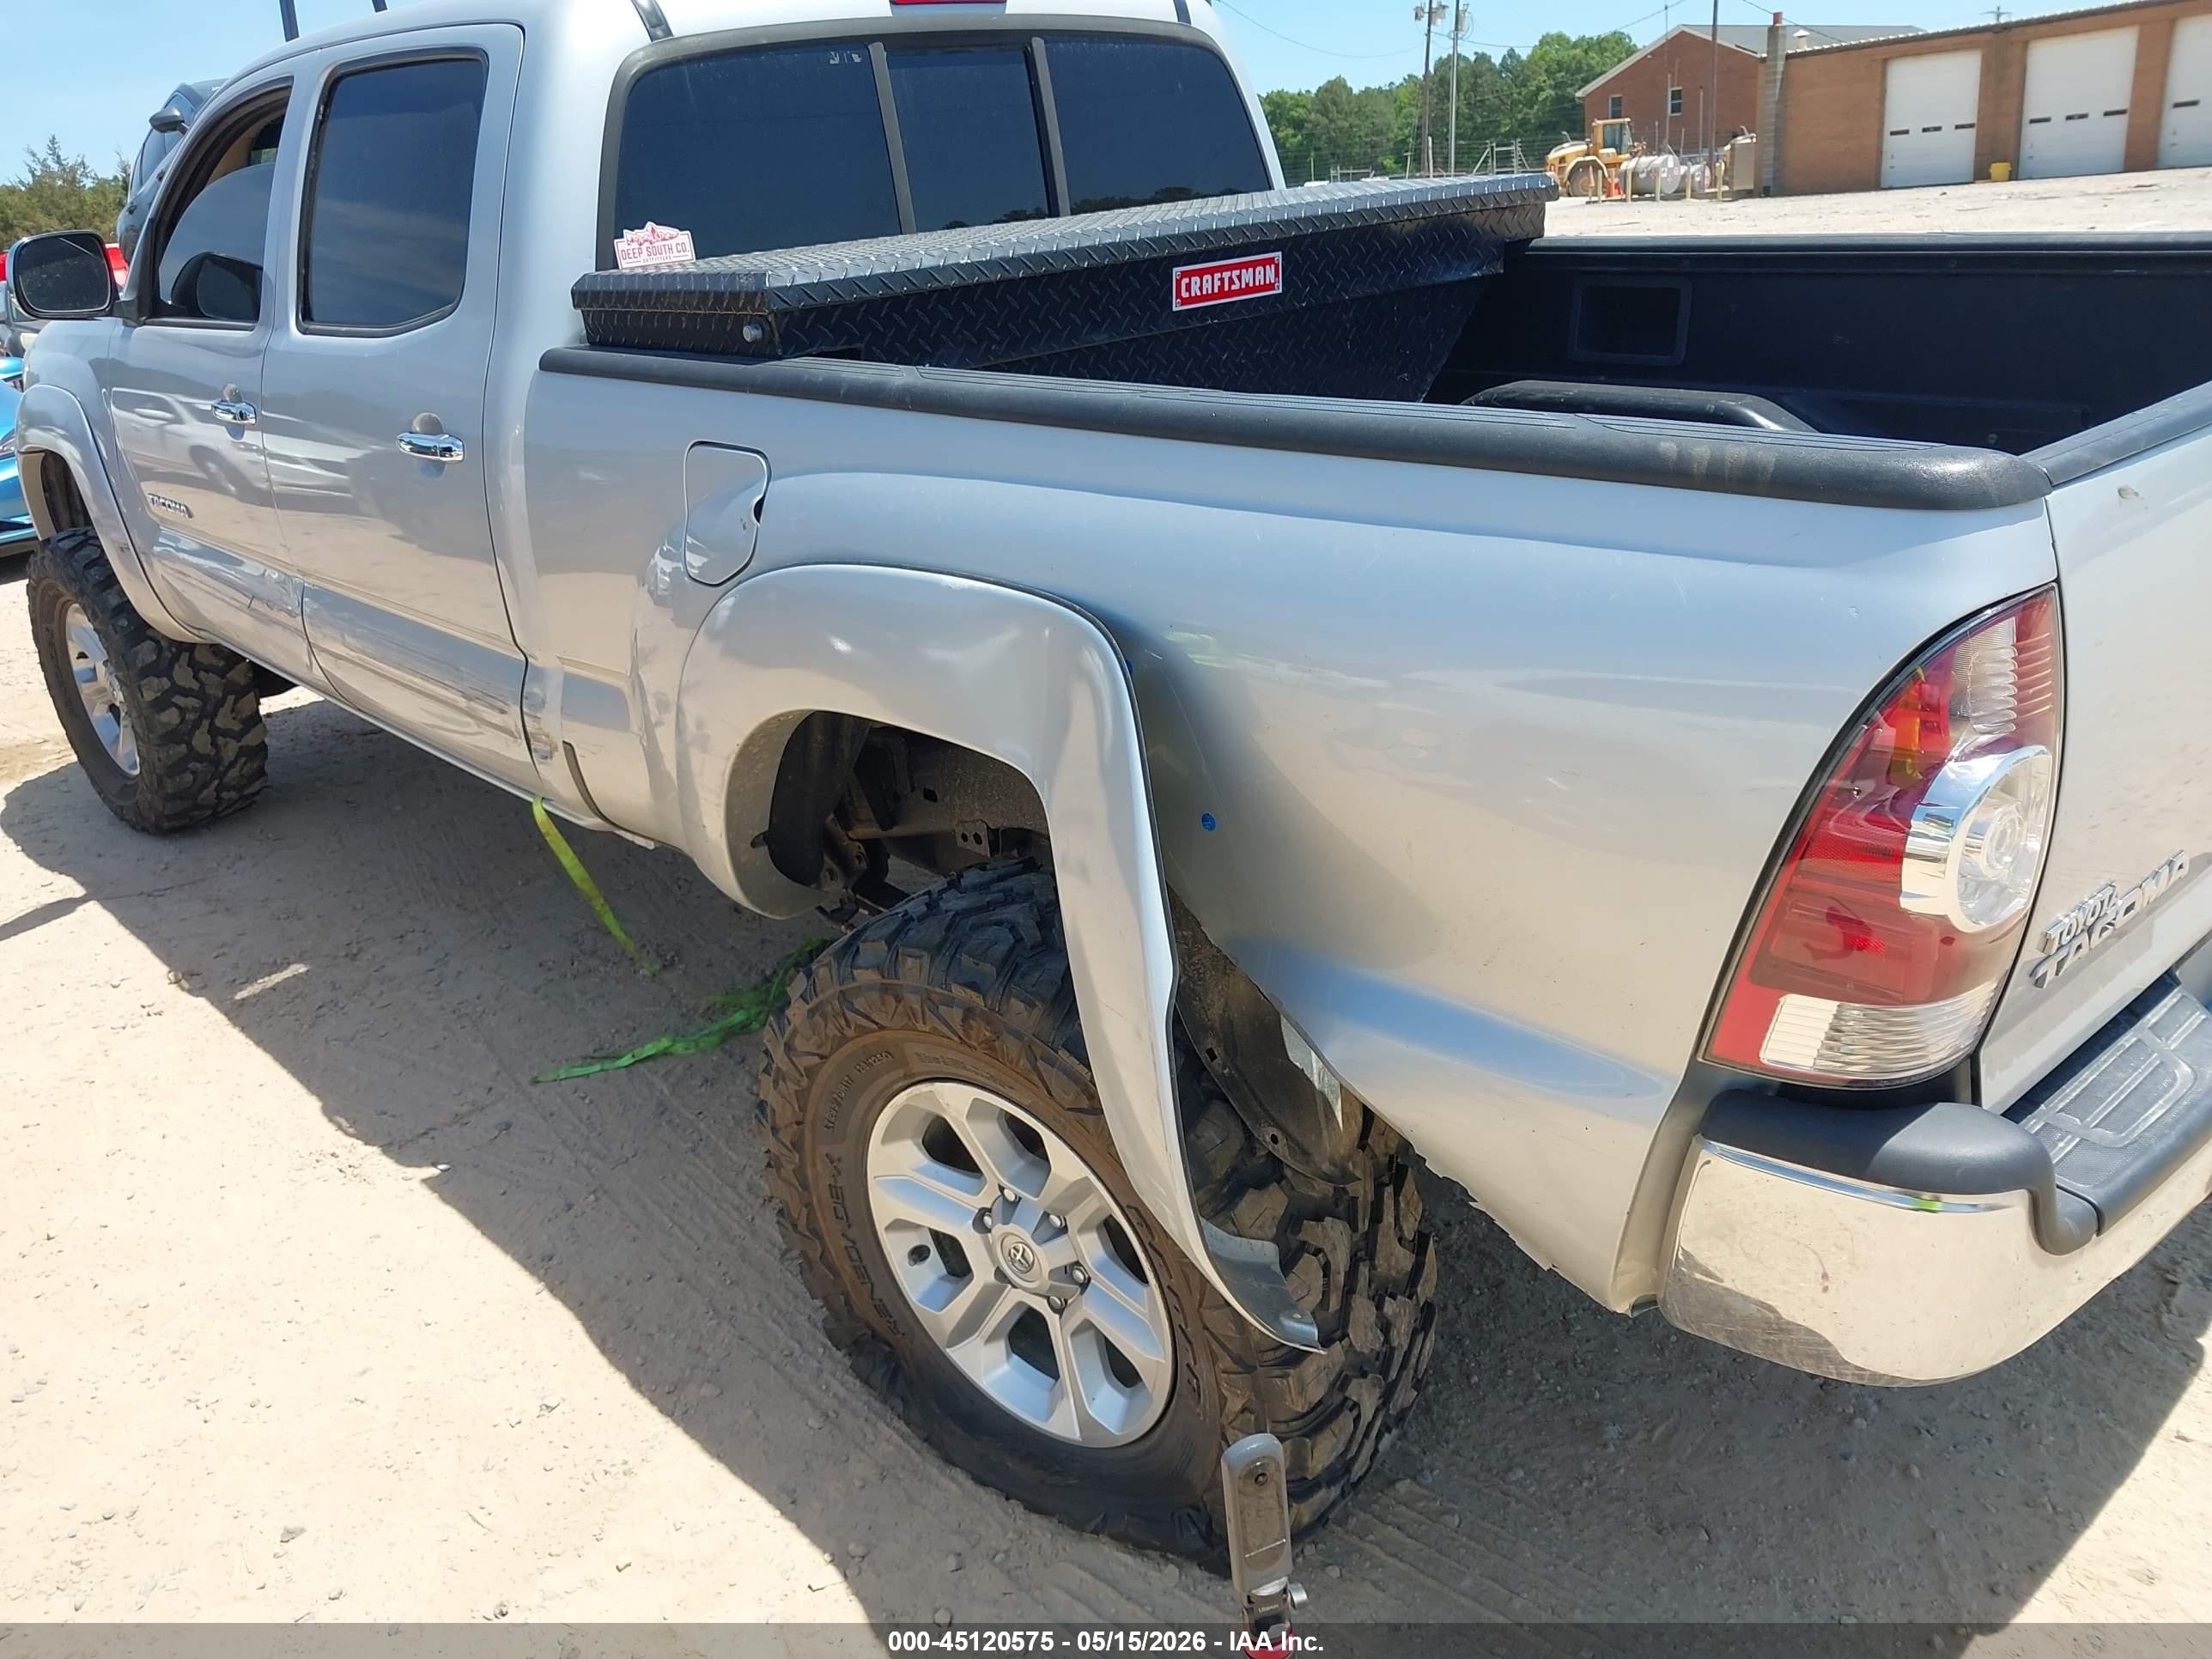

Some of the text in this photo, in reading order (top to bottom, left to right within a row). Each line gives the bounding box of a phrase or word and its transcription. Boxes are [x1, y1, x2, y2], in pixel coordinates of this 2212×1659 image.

[621, 241, 690, 260] DEEP SOUTH CO.
[1181, 264, 1276, 299] CRAFTSMAN
[2029, 849, 2190, 989] TACOMA
[2038, 880, 2119, 956] TOYOTA
